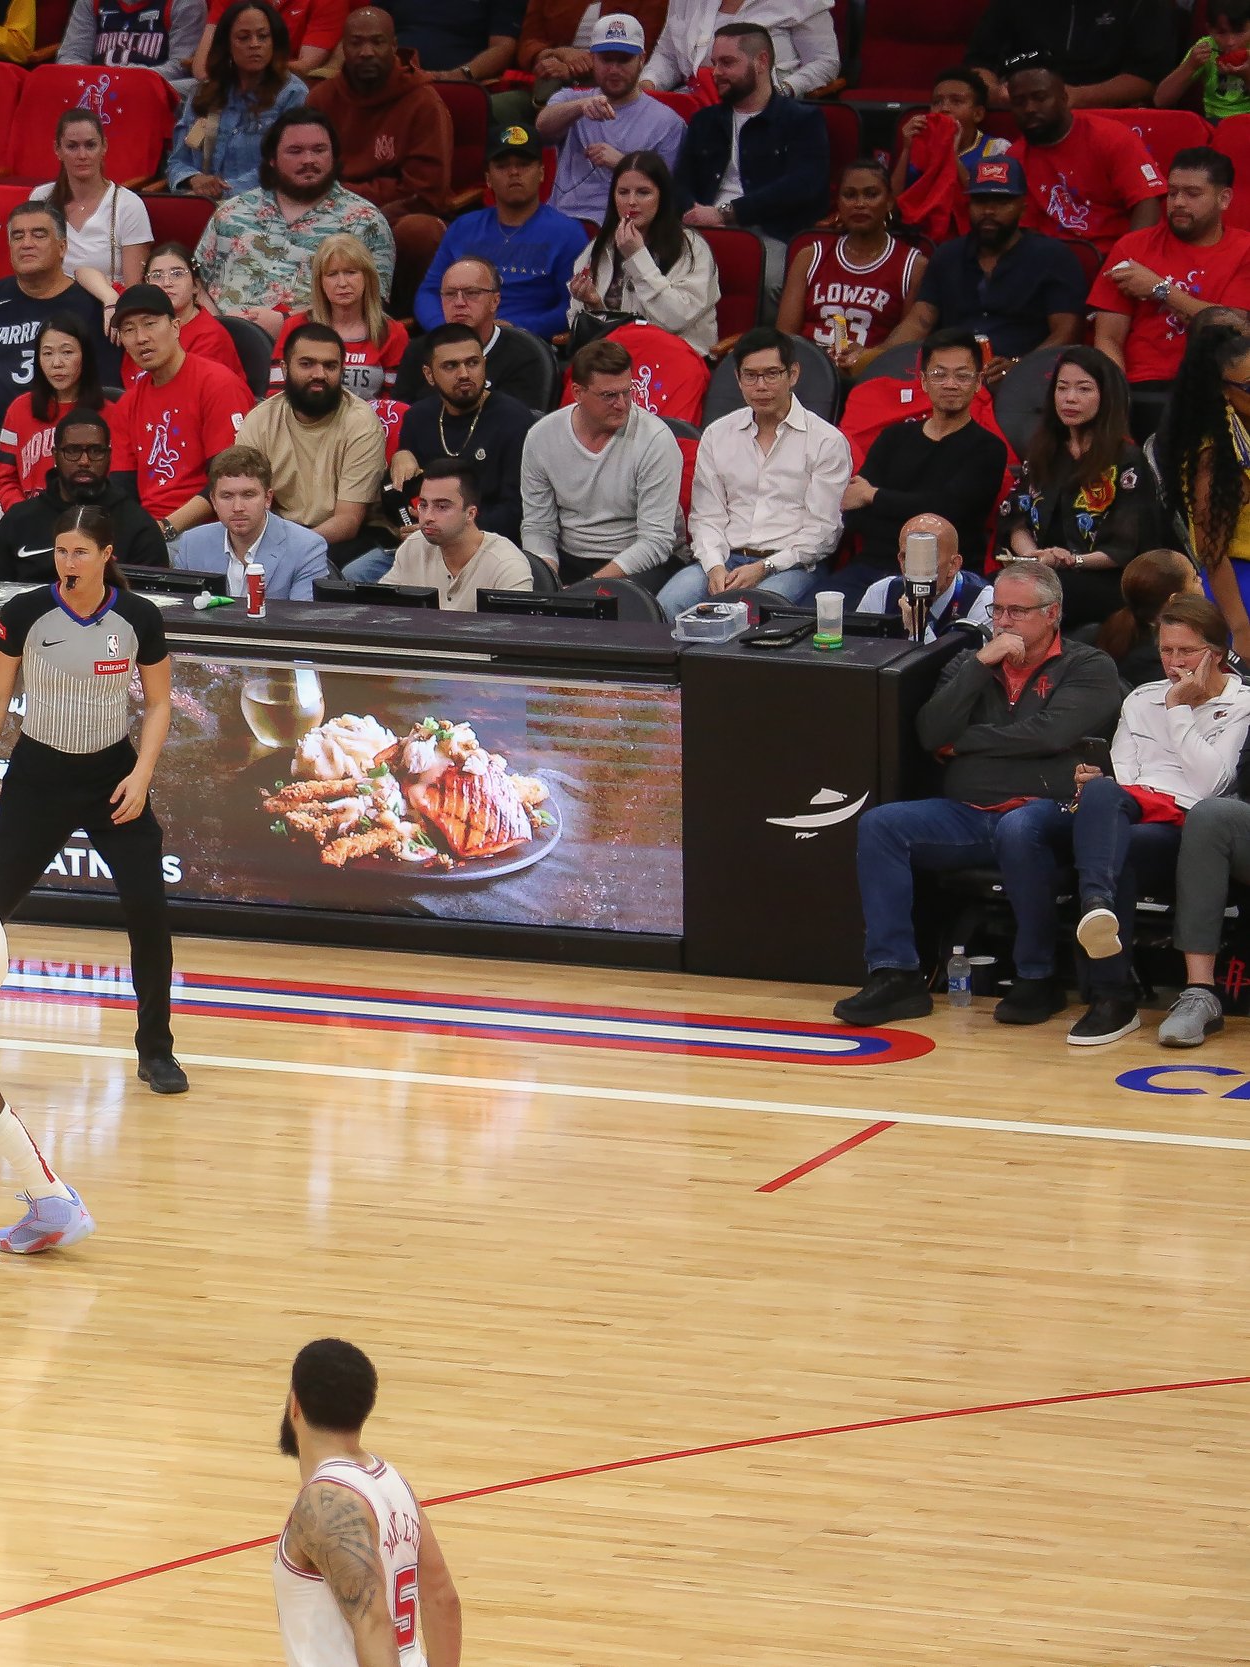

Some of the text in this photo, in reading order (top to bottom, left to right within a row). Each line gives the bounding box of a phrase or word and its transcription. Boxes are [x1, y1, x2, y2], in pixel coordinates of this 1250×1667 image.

[813, 282, 890, 312] LOWER
[814, 305, 873, 347] 33
[97, 663, 128, 673] Emirates
[393, 1564, 419, 1653] 5
